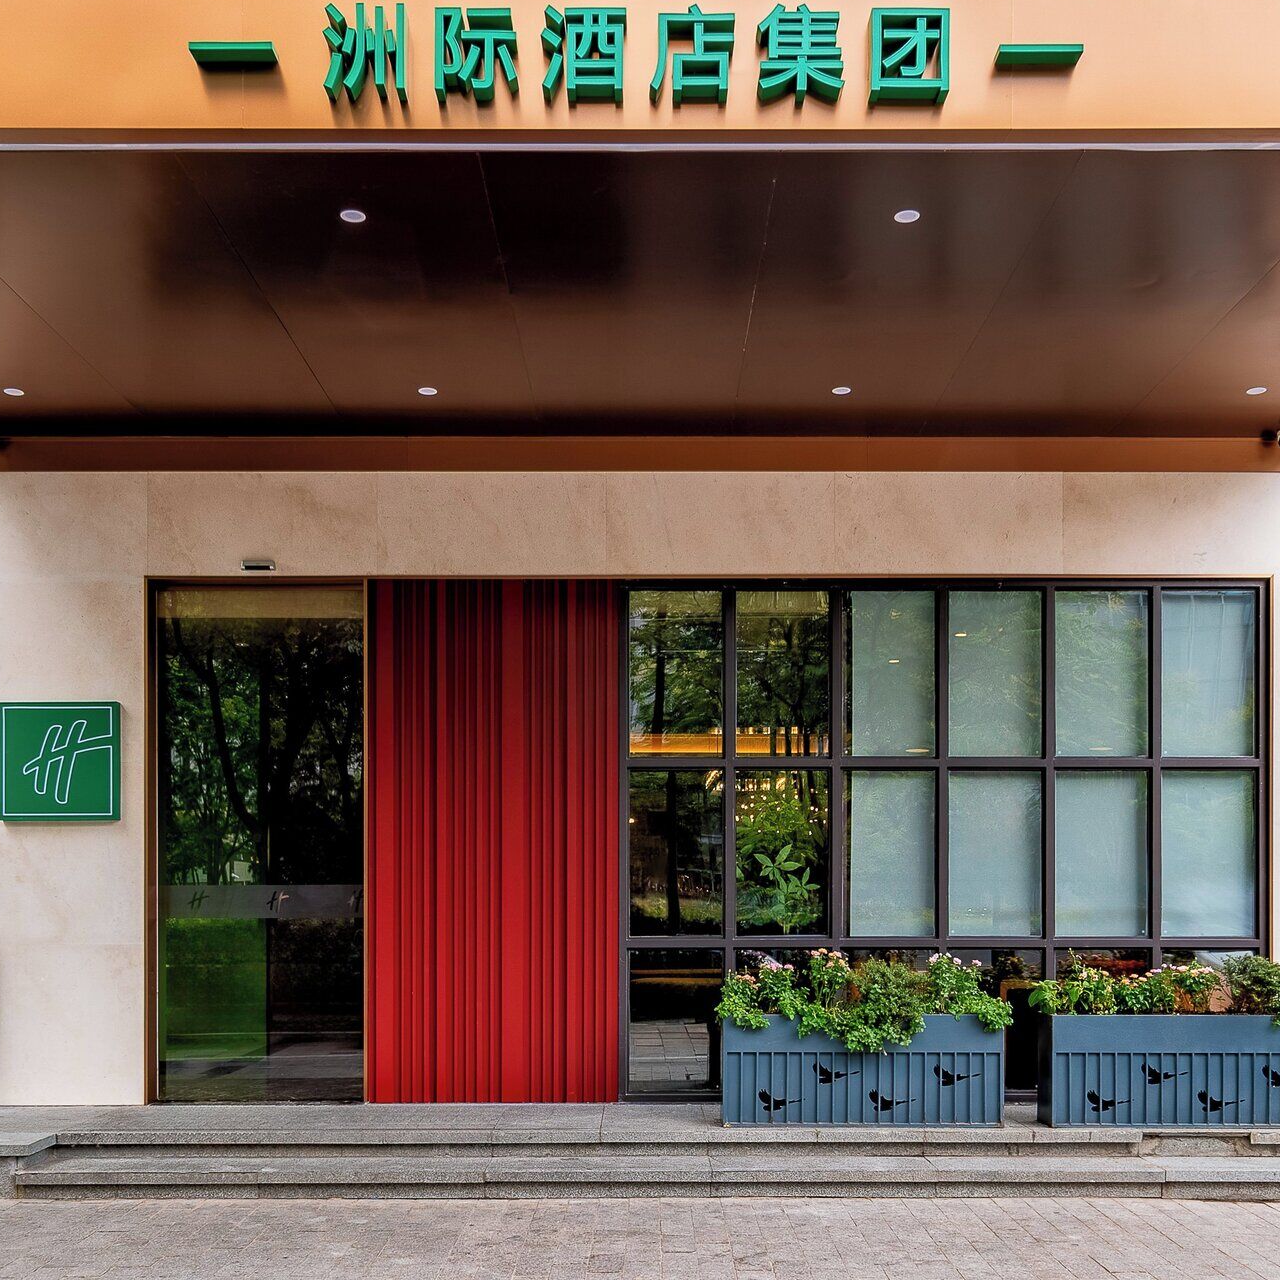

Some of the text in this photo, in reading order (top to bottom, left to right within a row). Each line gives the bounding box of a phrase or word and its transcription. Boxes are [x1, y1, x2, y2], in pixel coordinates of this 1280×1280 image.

[323, 2, 950, 107] 洲际酒店集团
